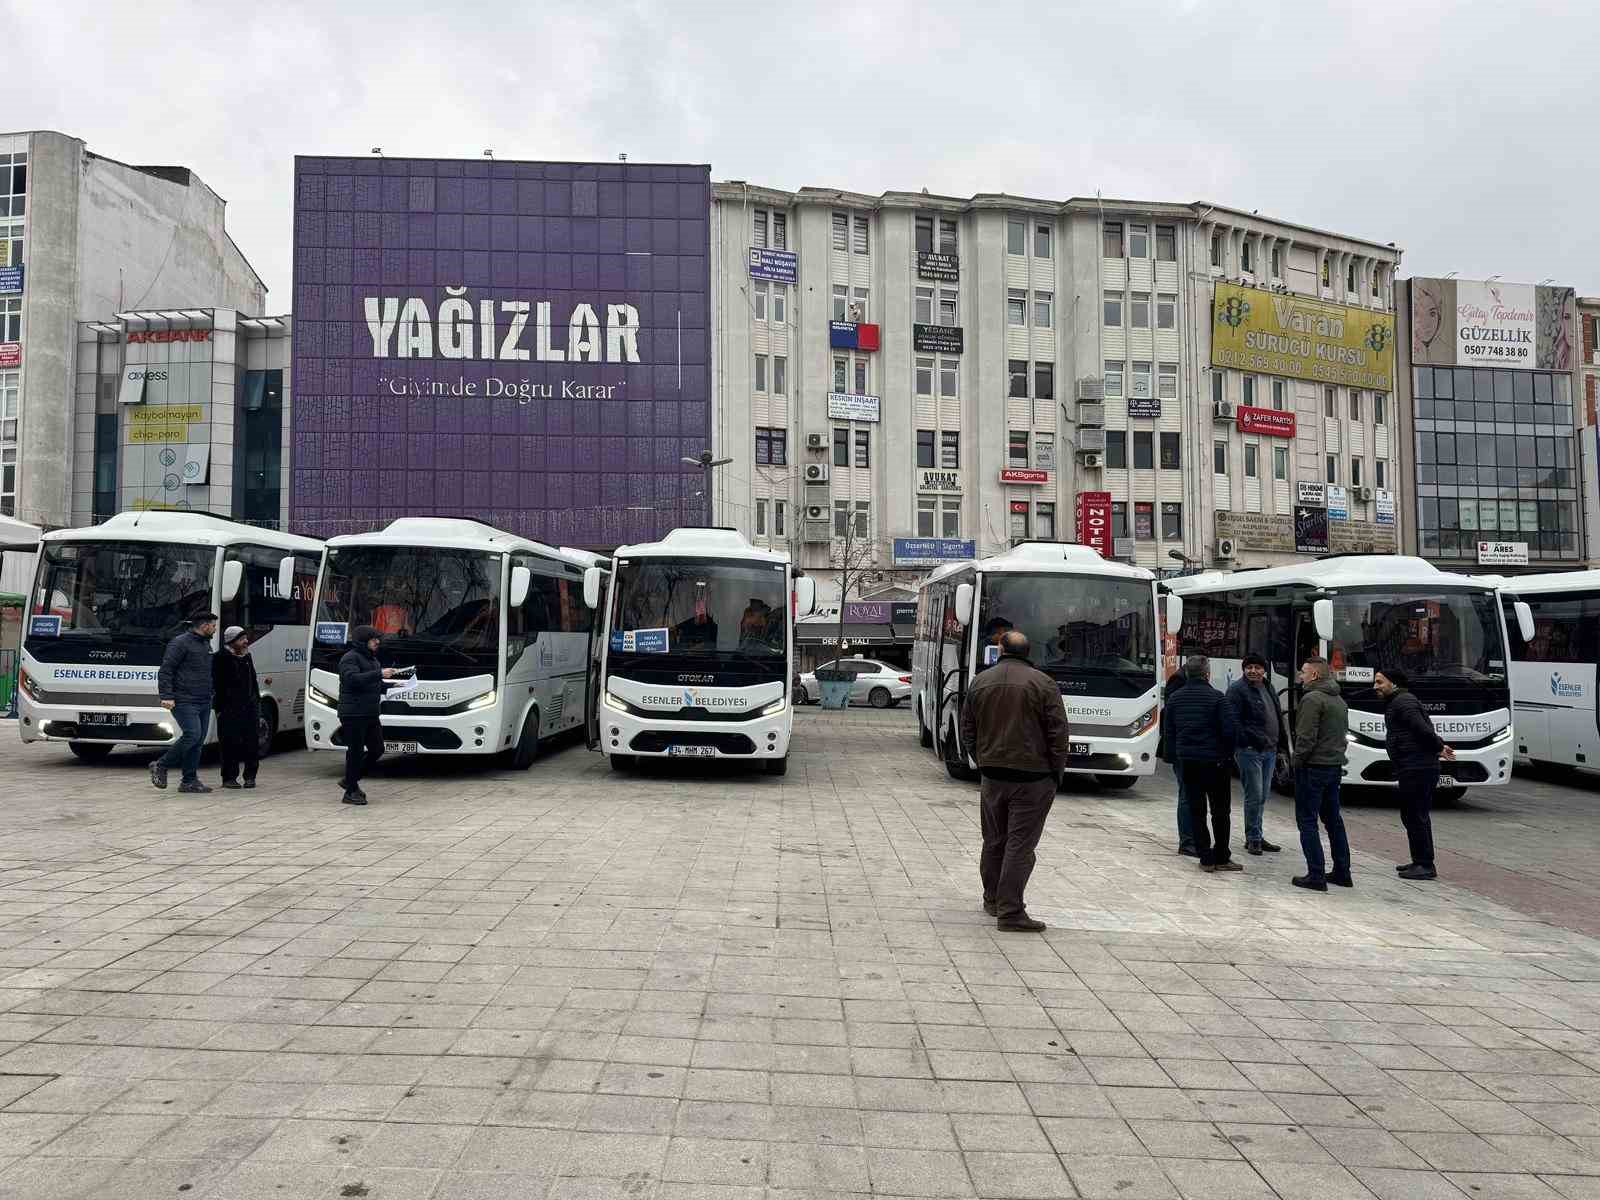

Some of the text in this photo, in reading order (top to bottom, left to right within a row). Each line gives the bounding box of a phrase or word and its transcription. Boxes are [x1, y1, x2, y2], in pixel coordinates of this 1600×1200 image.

[1272, 297, 1345, 338] Varan
[363, 286, 641, 363] YAĞIZLAR
[128, 330, 209, 344] AKBANK
[1460, 325, 1533, 344] GÜZELLİK
[1245, 328, 1367, 368] SÜRÜCÜ KURSU
[1464, 345, 1529, 357] 0507 748 38 80
[1218, 350, 1247, 366] 0212
[128, 371, 168, 381] axess
[486, 377, 553, 405] Doğru
[1252, 413, 1272, 422] ZAFER
[923, 471, 958, 482] AVUKAT
[849, 603, 883, 617] ROYAL
[54, 669, 157, 681] ESENLER BELEDİYESİ
[677, 673, 714, 683] OTOKAR
[642, 695, 748, 707] ESENLER BELEDİYESİ
[1067, 706, 1111, 717] BELEDİYESİ
[1434, 721, 1491, 734] ELEDİYESİ
[1075, 744, 1088, 753] 135
